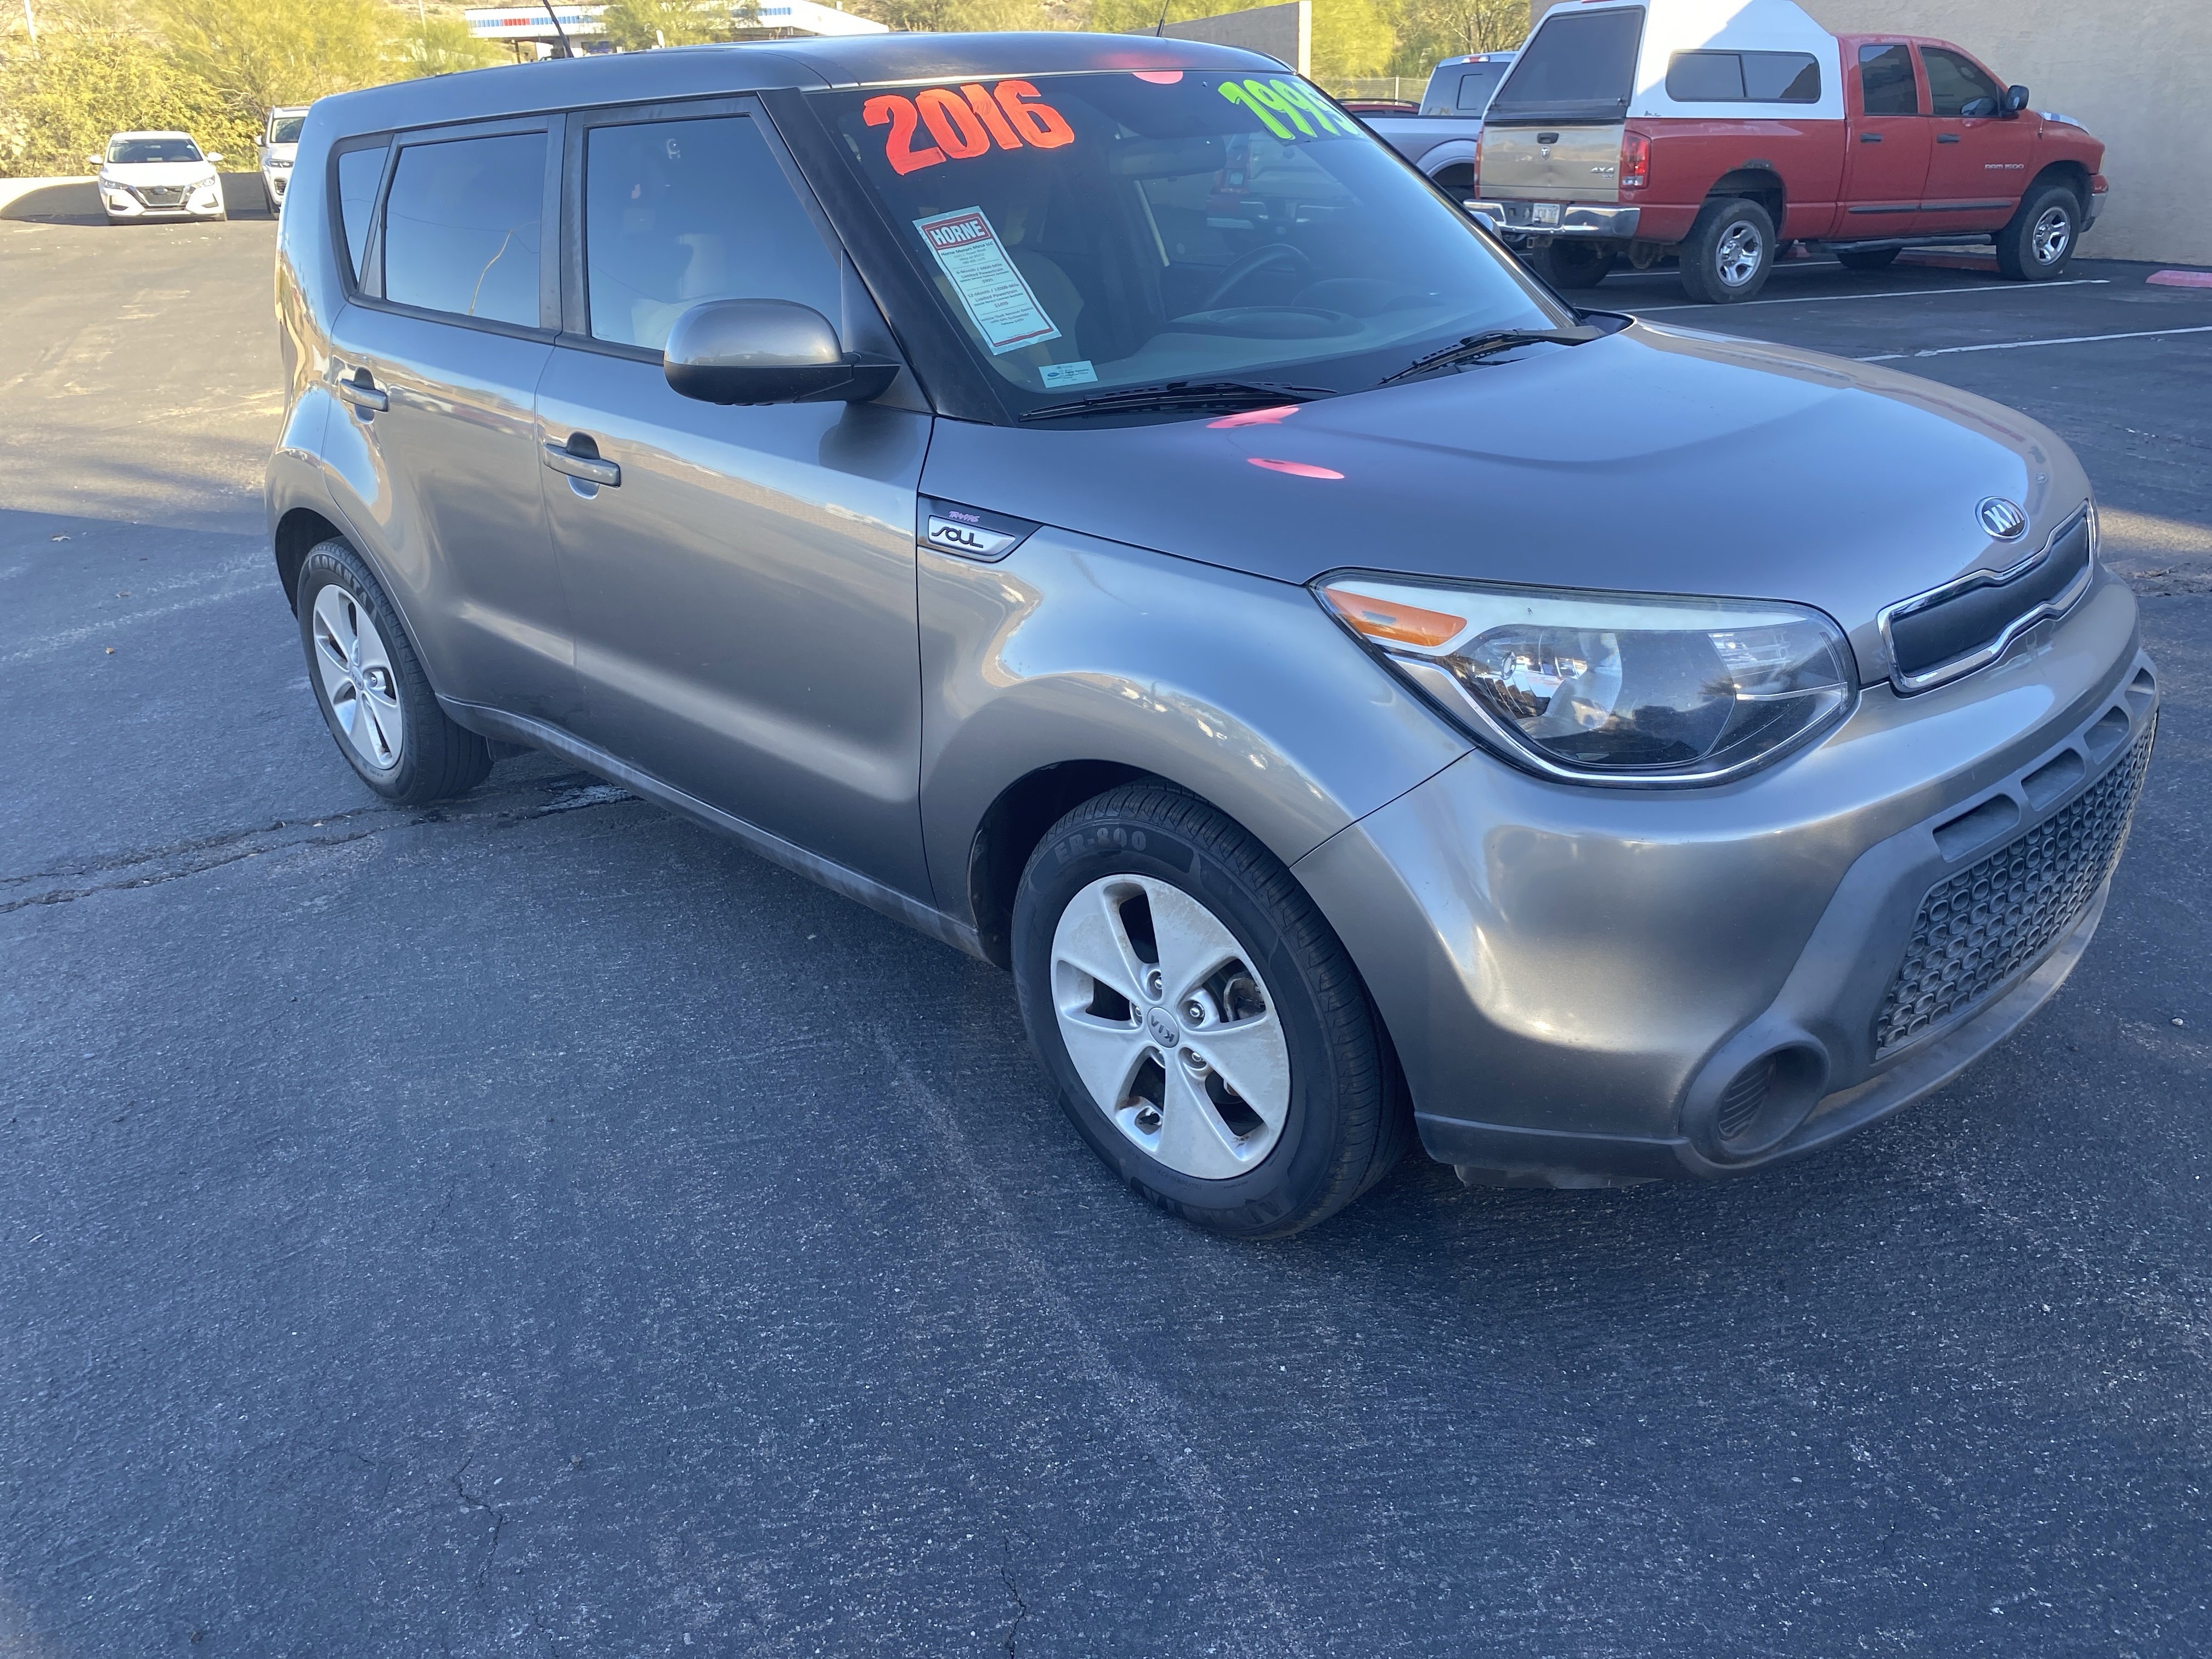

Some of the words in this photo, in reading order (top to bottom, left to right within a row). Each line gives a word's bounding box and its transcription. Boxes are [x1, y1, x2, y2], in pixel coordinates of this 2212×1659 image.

[863, 80, 1074, 175] 2016
[930, 221, 985, 245] HORNE
[993, 289, 1018, 297] Powertrain
[1983, 501, 2025, 533] KIA
[931, 526, 984, 549] SOUL
[314, 555, 367, 606] ADVANTA
[1054, 827, 1147, 865] ER-800
[1151, 1013, 1175, 1043] KIA
